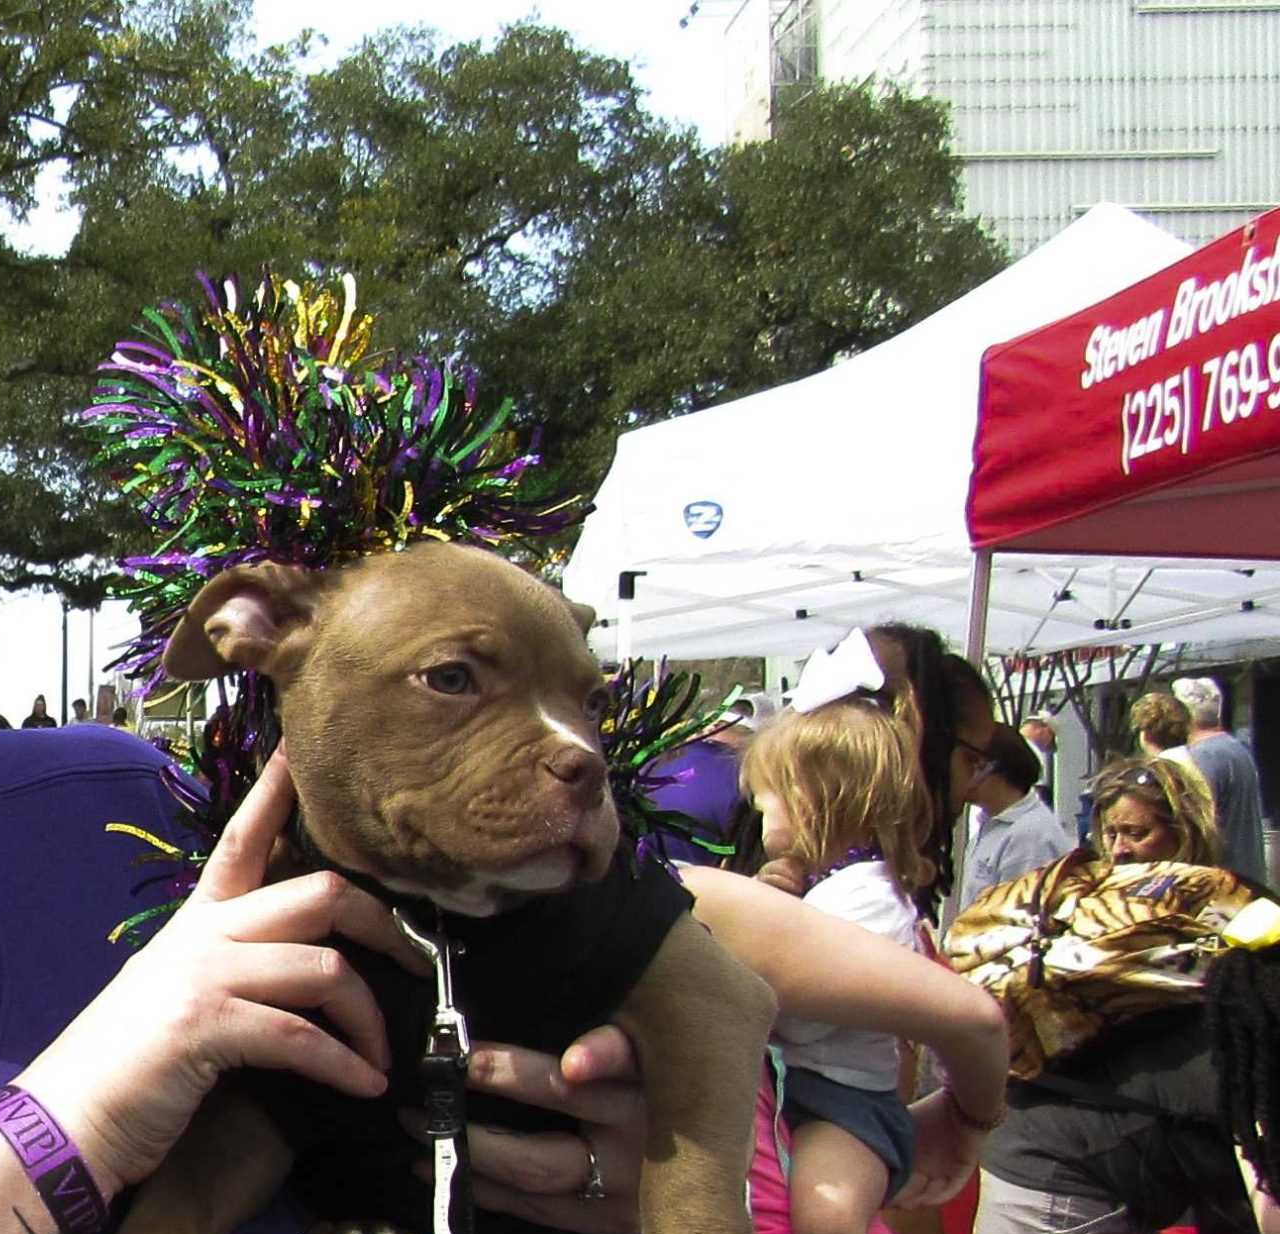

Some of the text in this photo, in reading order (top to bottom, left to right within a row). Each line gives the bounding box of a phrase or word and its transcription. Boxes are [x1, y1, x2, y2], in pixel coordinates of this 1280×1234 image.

[1081, 308, 1165, 390] Steven
[1122, 365, 1191, 476] (225)
[3, 1100, 102, 1230] VIP VIP
